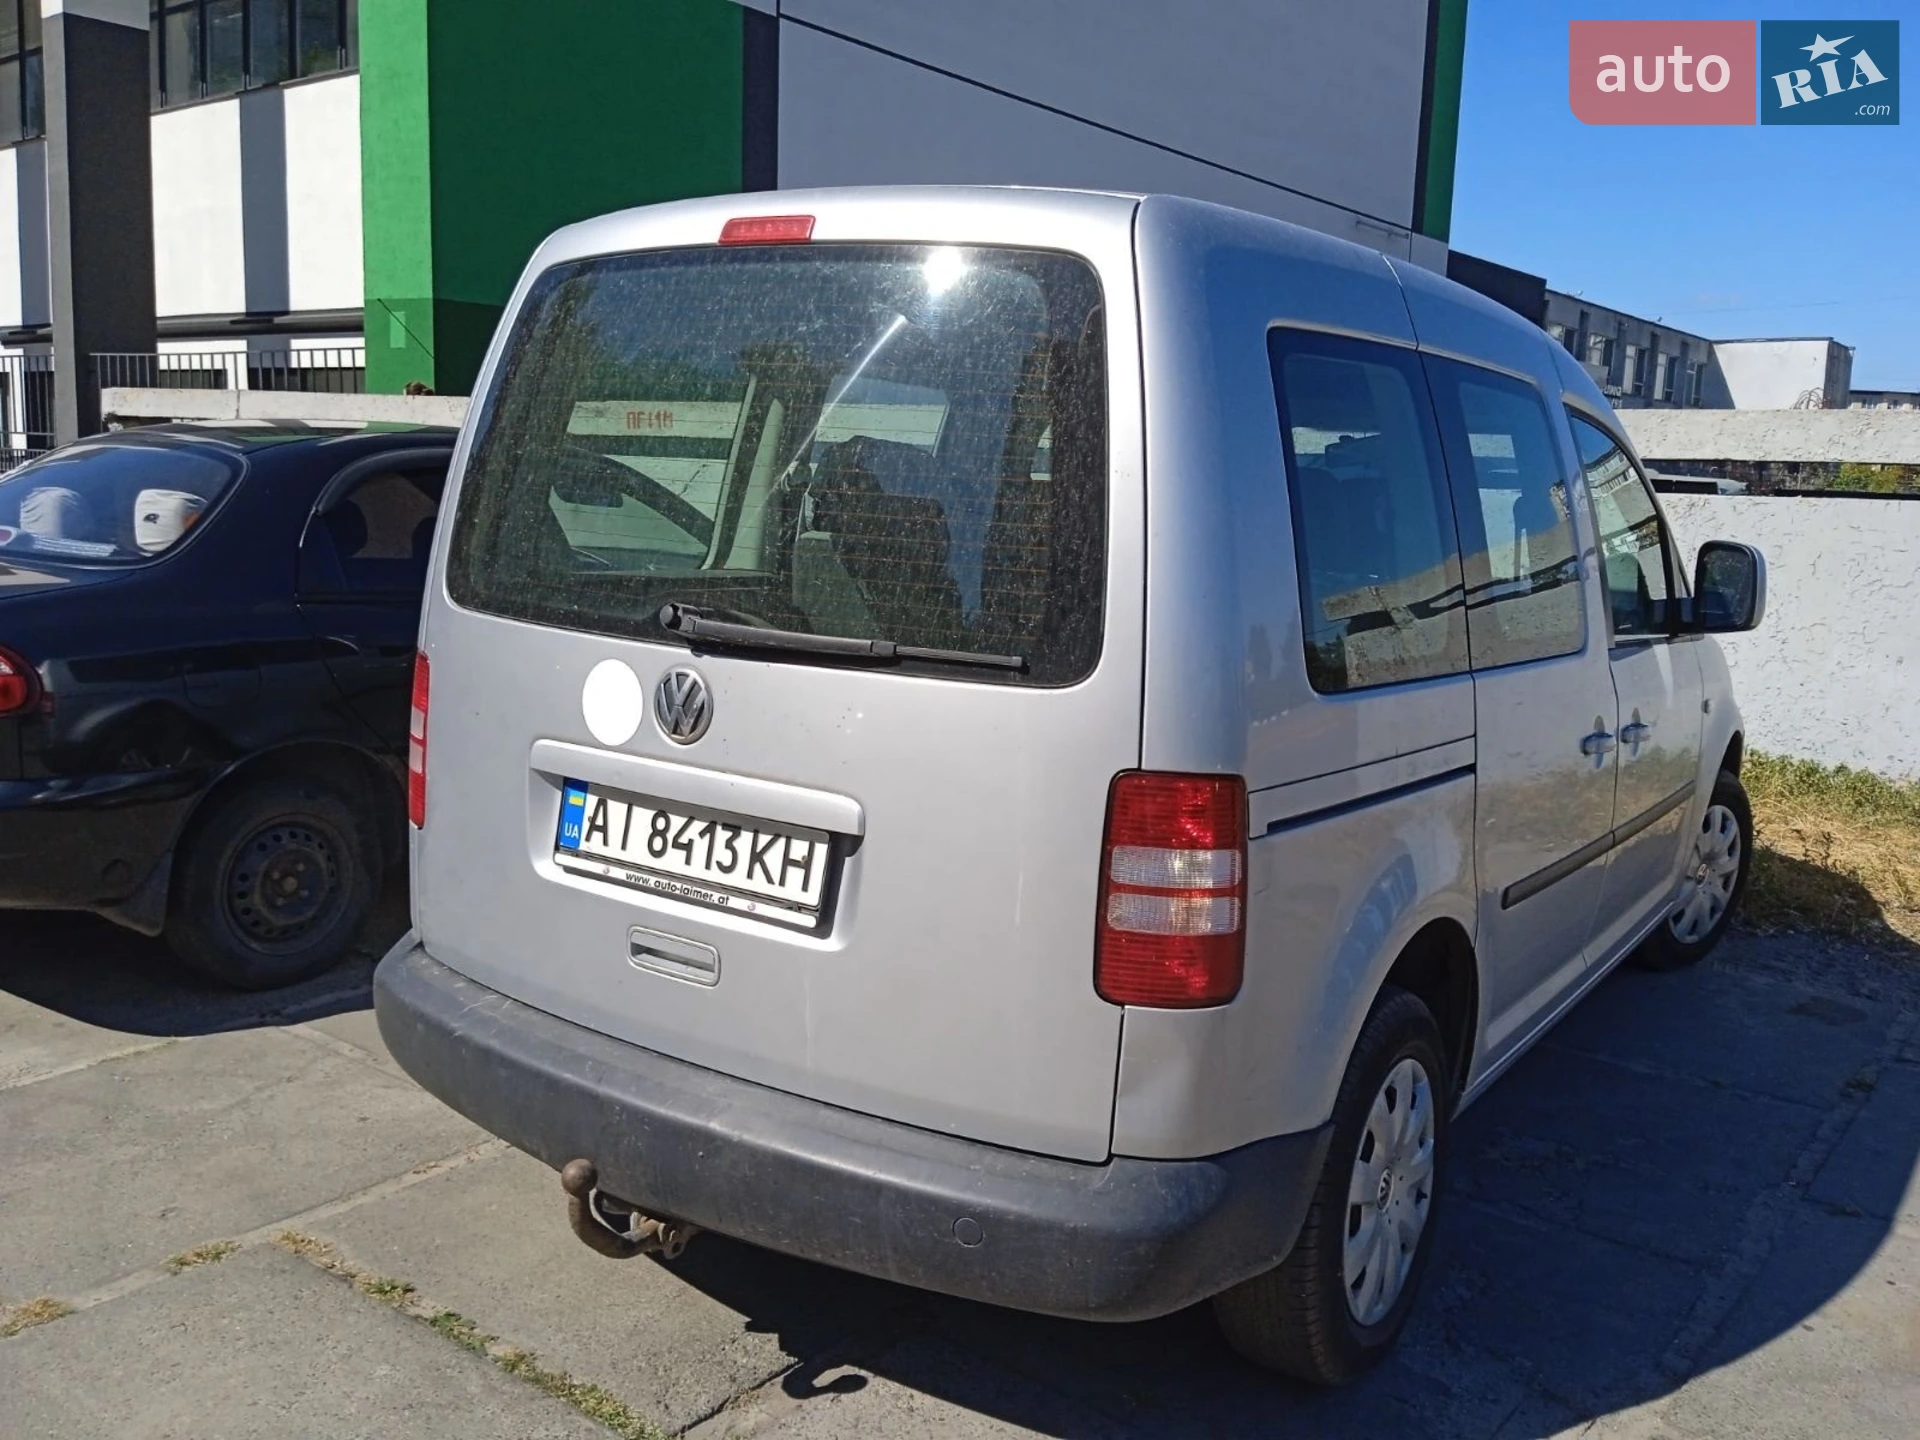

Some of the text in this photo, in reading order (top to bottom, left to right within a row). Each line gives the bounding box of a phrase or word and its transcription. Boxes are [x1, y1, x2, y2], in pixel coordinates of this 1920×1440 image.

[564, 822, 579, 839] UA
[584, 797, 816, 893] AI 8413 KH
